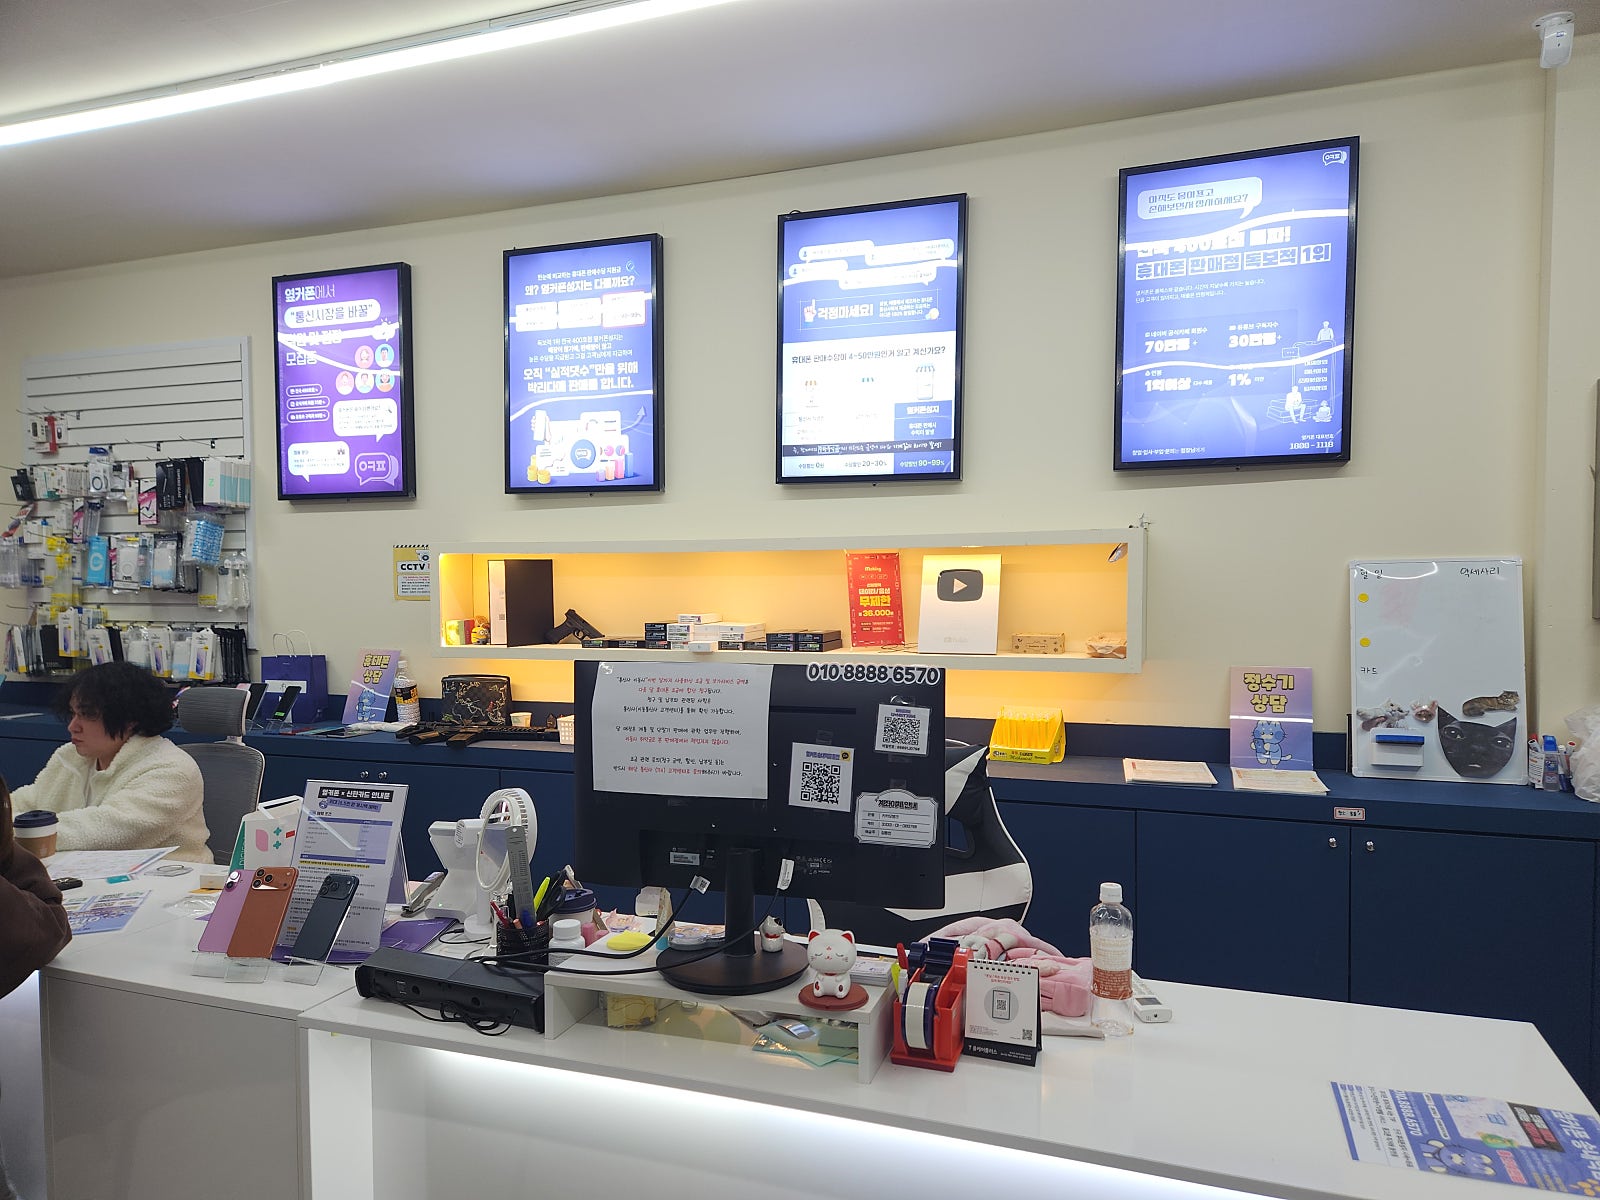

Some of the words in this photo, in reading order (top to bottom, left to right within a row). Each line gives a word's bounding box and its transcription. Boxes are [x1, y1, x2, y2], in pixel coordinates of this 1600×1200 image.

[1136, 259, 1186, 280] 휴대폰
[1189, 253, 1241, 276] 판매점
[1243, 247, 1297, 271] 독보적
[1300, 243, 1331, 265] 1위
[284, 283, 336, 303] 옆커폰에서
[524, 285, 539, 296] 왜?
[818, 303, 874, 320] 걱정마세요!
[792, 354, 811, 364] 휴대폰
[912, 346, 946, 356] 계신가요?
[524, 368, 542, 380] 오직
[618, 361, 638, 374] 위해
[600, 376, 634, 390] 합니다.
[1228, 373, 1252, 386] 1%
[860, 595, 891, 607] 무제한
[363, 654, 391, 669] 휴대폰
[1360, 666, 1377, 674] 카드
[363, 670, 382, 684] 상담
[808, 664, 840, 681] 010
[843, 665, 888, 682] 8888
[892, 667, 940, 685] 6570
[1244, 673, 1294, 692] 정수기
[1250, 694, 1288, 713] 상담
